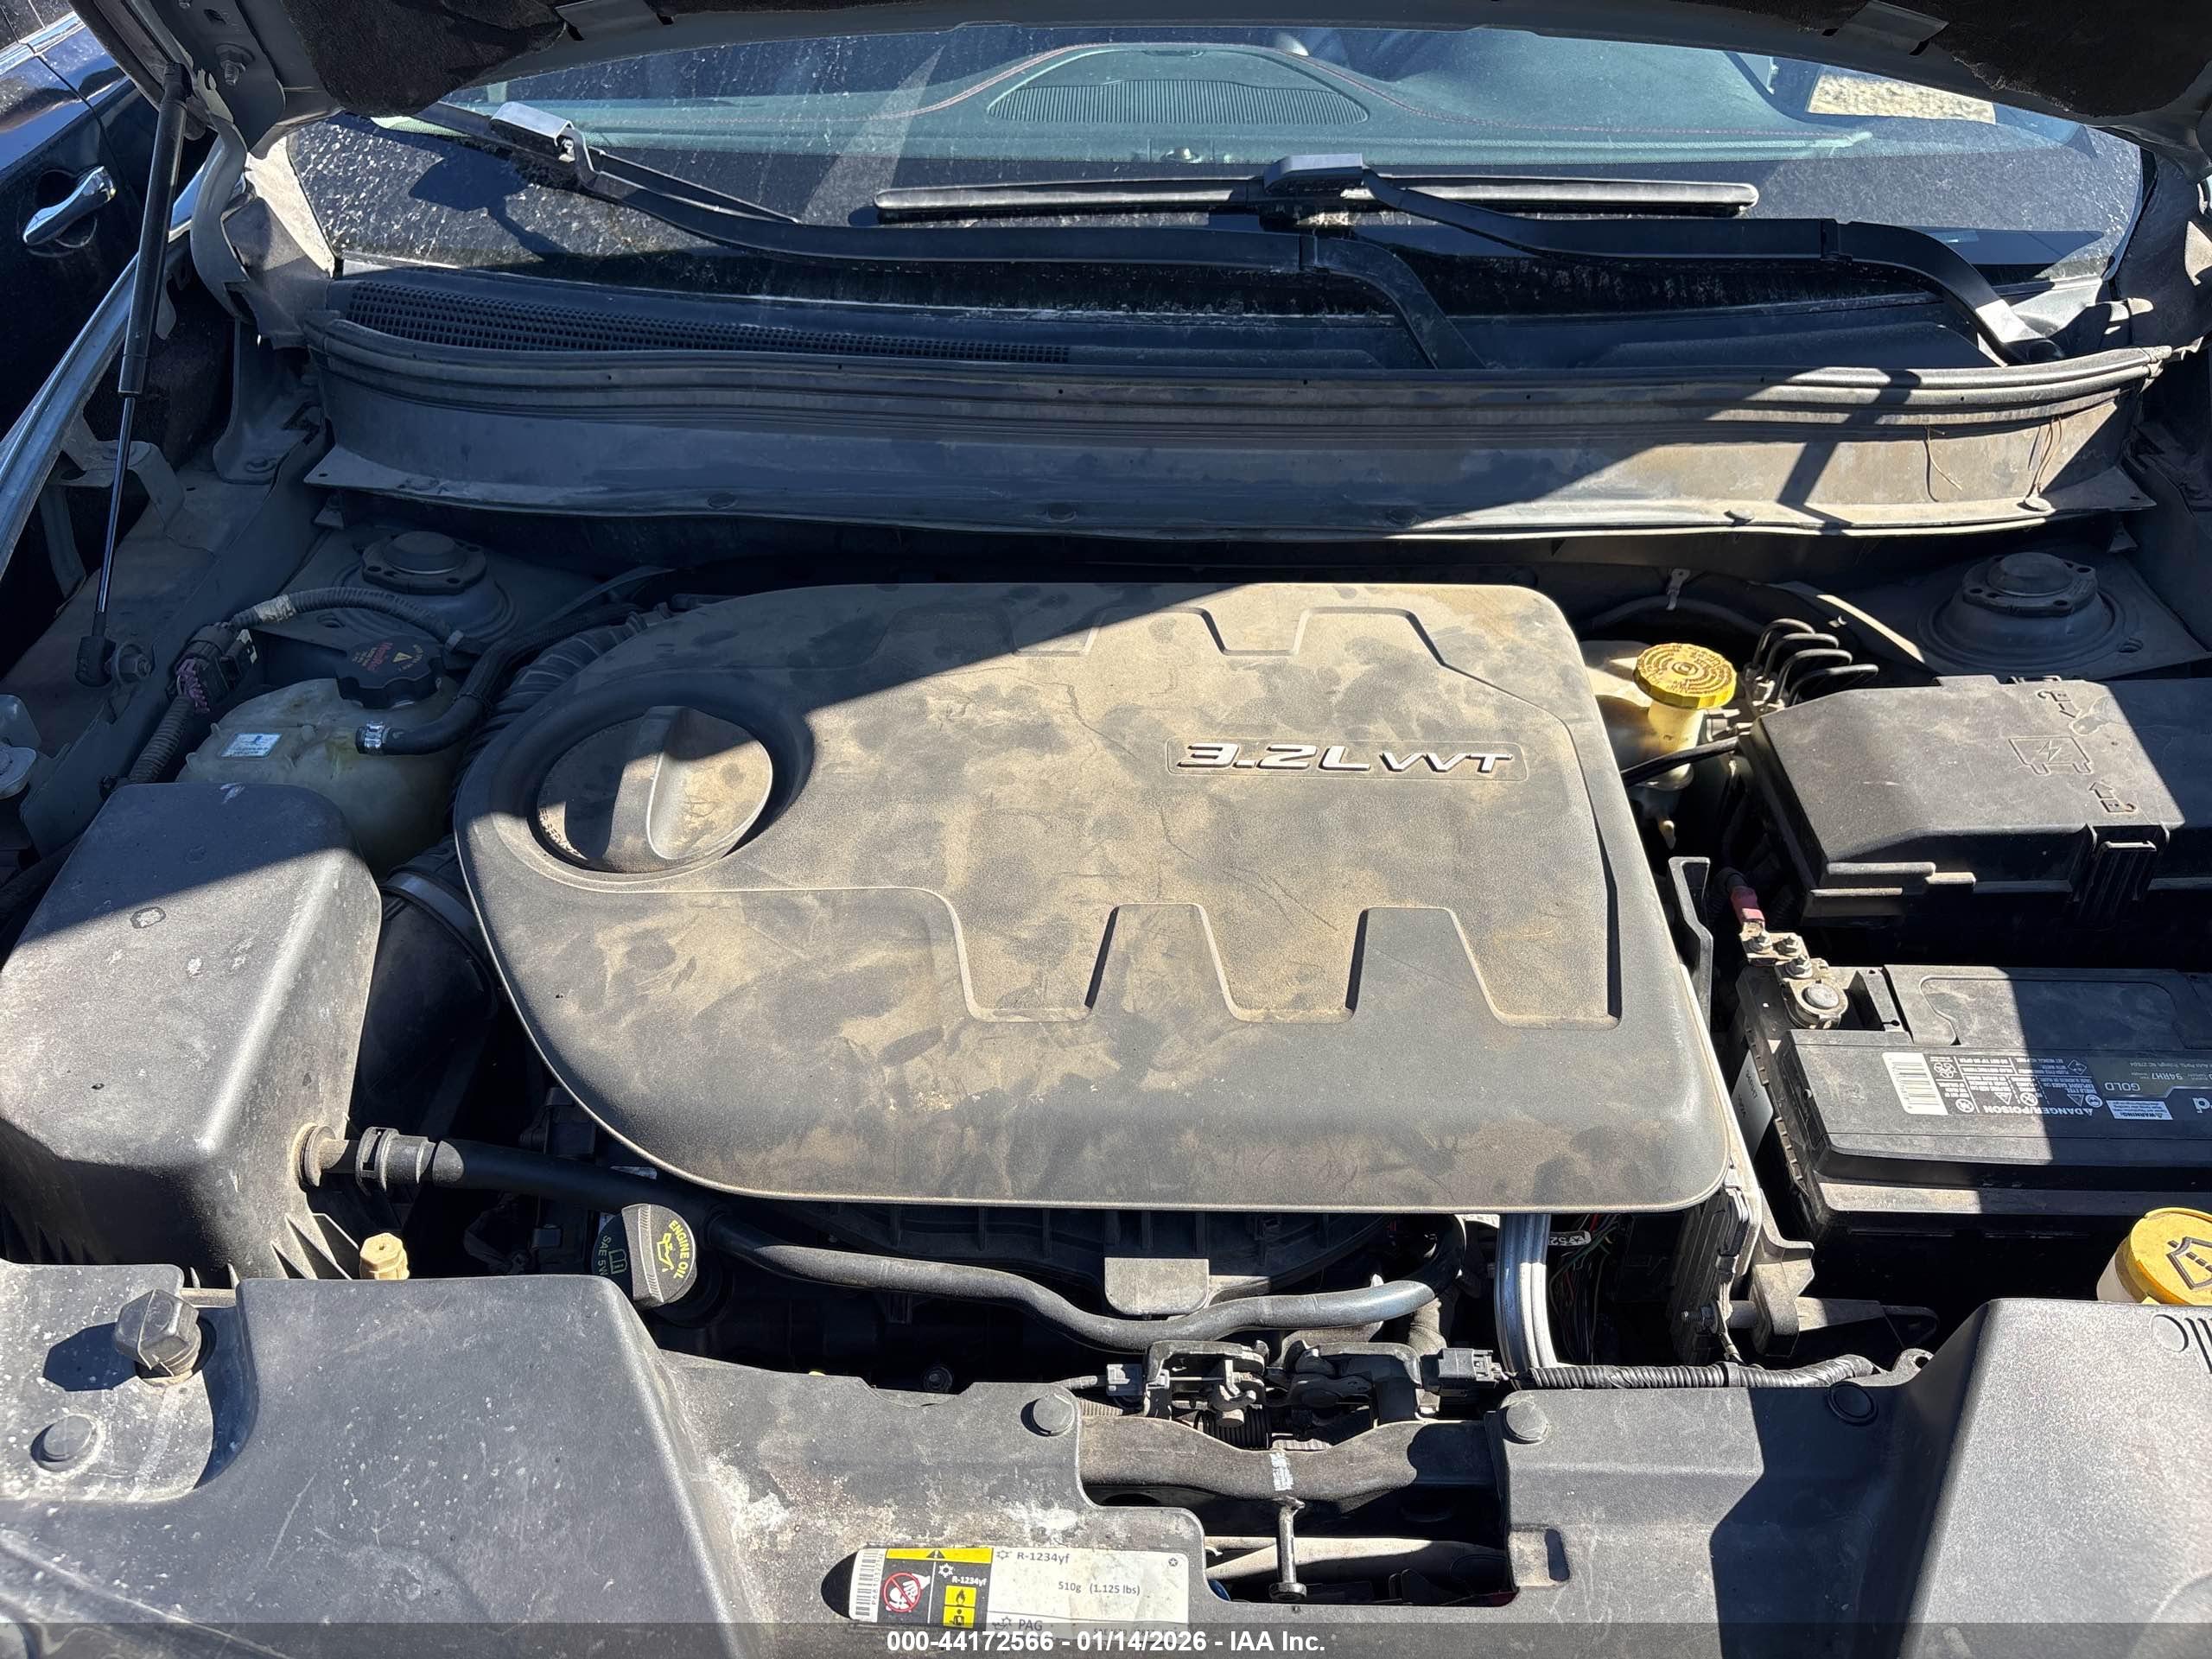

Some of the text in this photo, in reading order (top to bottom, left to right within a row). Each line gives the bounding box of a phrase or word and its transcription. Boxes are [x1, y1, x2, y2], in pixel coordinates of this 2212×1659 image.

[1177, 742, 1513, 774] 3.2L VVT
[2104, 1082, 2141, 1091] GOLD
[1983, 1105, 2084, 1116] DANGER/POISON
[598, 1235, 612, 1256] SAE
[669, 1220, 690, 1279] ENGINE OIL
[1016, 1550, 1071, 1565] R-1234yf
[950, 1575, 987, 1587] R-1234yf
[1058, 1580, 1141, 1597] 510g (1.125 lbs)
[1018, 1618, 1044, 1631] PAG
